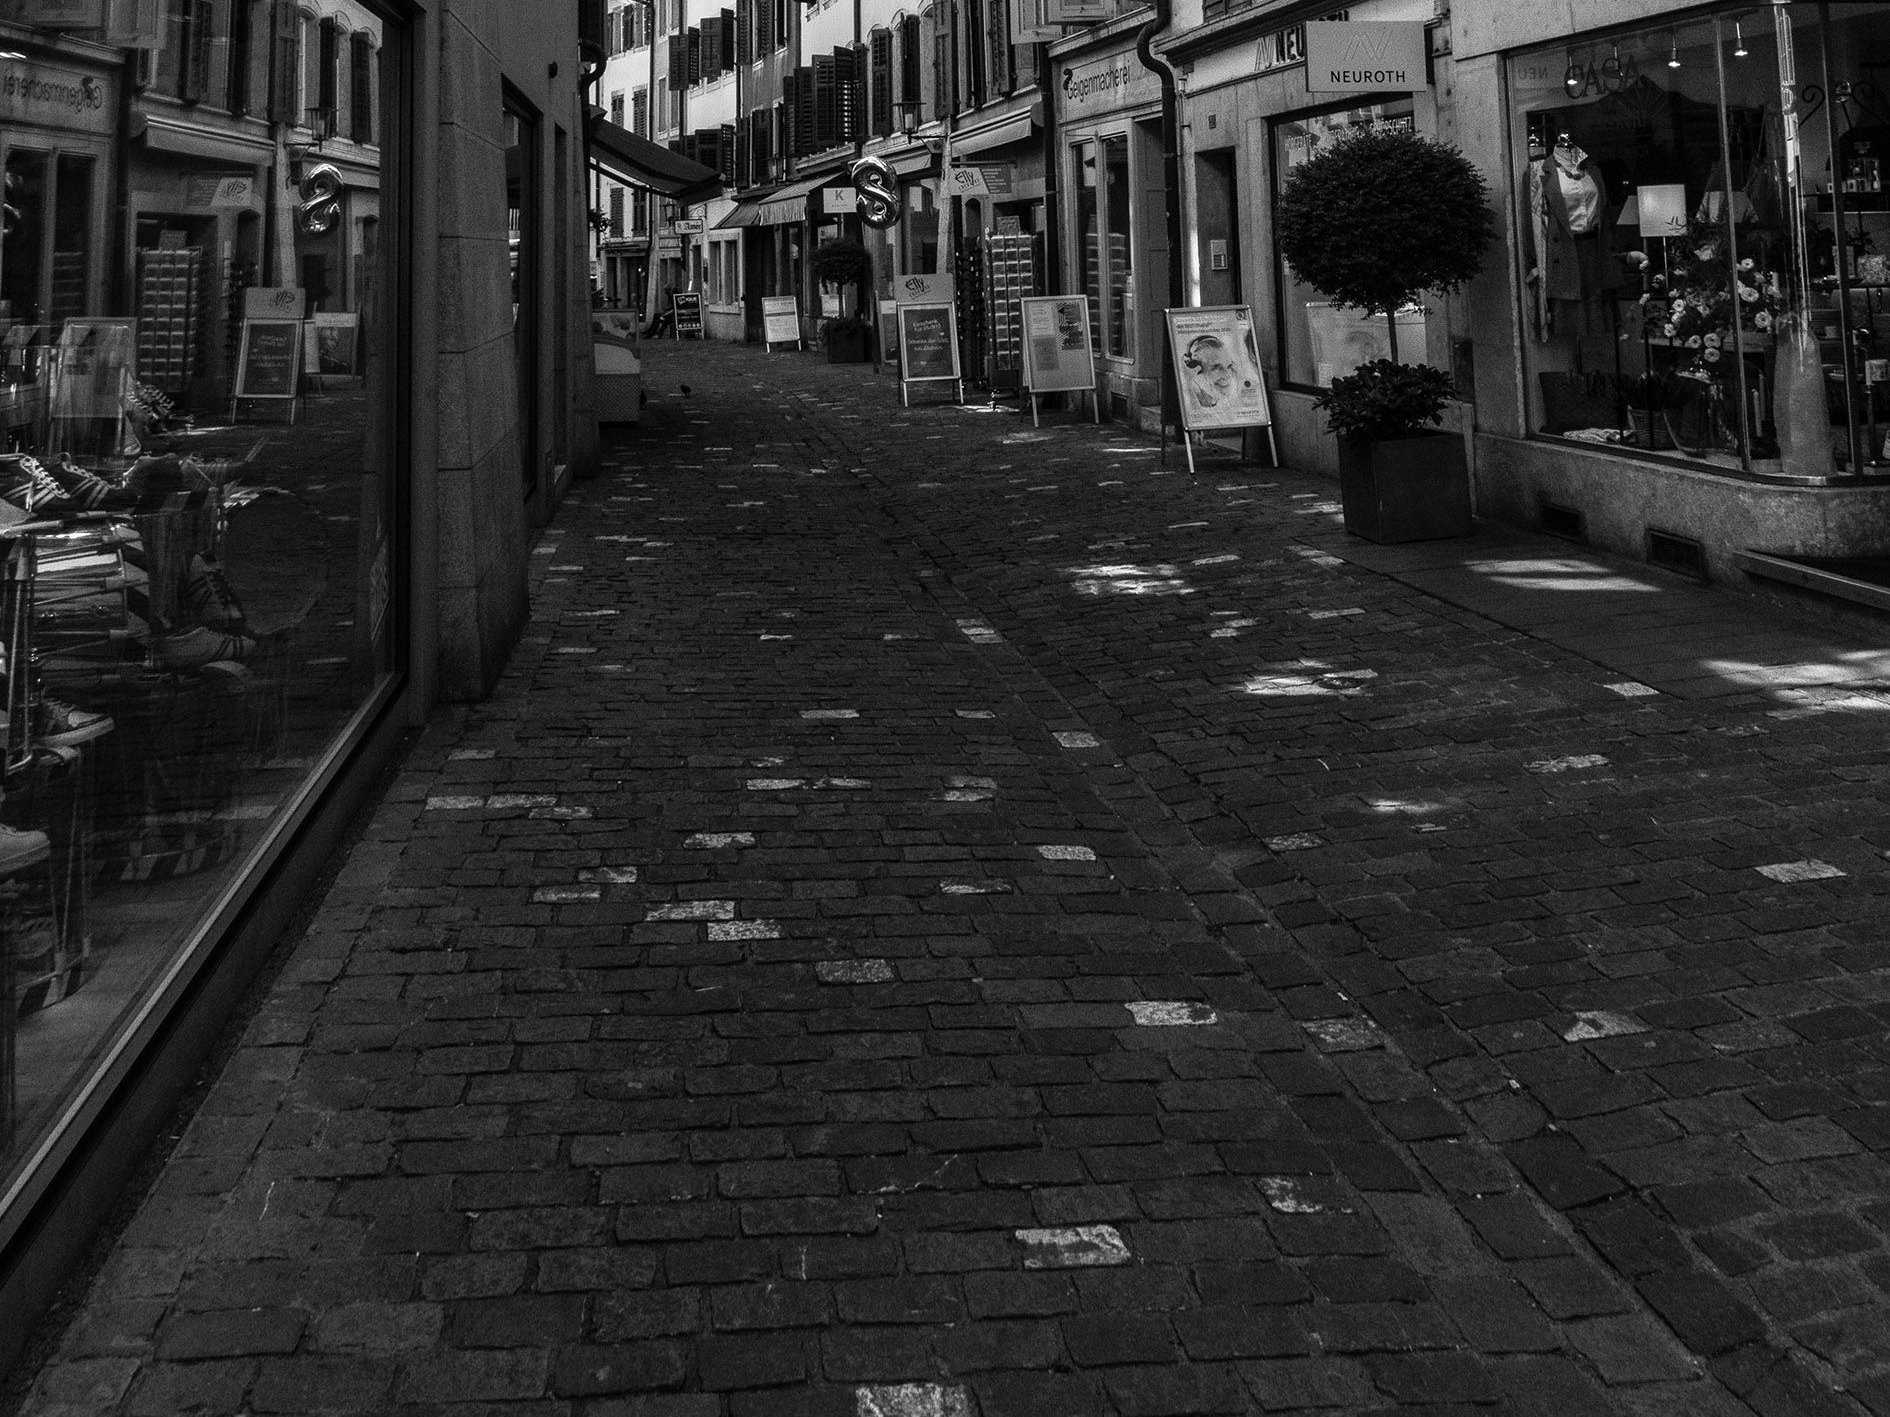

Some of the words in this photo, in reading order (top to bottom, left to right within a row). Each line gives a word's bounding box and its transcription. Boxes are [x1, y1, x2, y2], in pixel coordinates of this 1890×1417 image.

[1067, 60, 1131, 102] Geigenmacherei
[1331, 70, 1405, 82] NEUROTH
[1564, 54, 1641, 99] CASA
[835, 190, 844, 200] K
